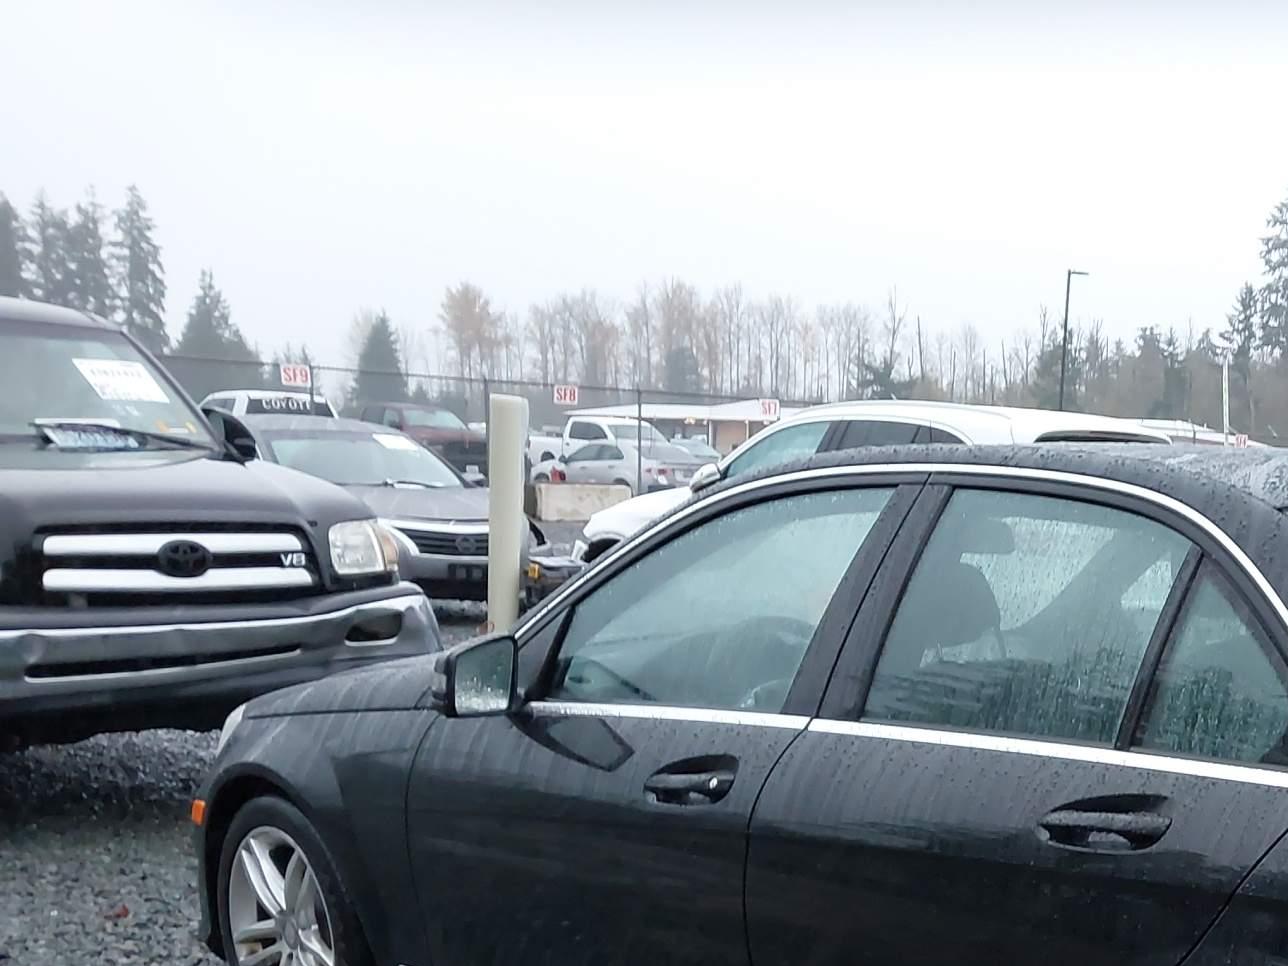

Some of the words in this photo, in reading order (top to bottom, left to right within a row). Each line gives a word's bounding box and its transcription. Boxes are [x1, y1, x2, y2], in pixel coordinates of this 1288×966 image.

[283, 367, 308, 383] SF9
[556, 387, 576, 401] SF8
[280, 552, 305, 567] V8
